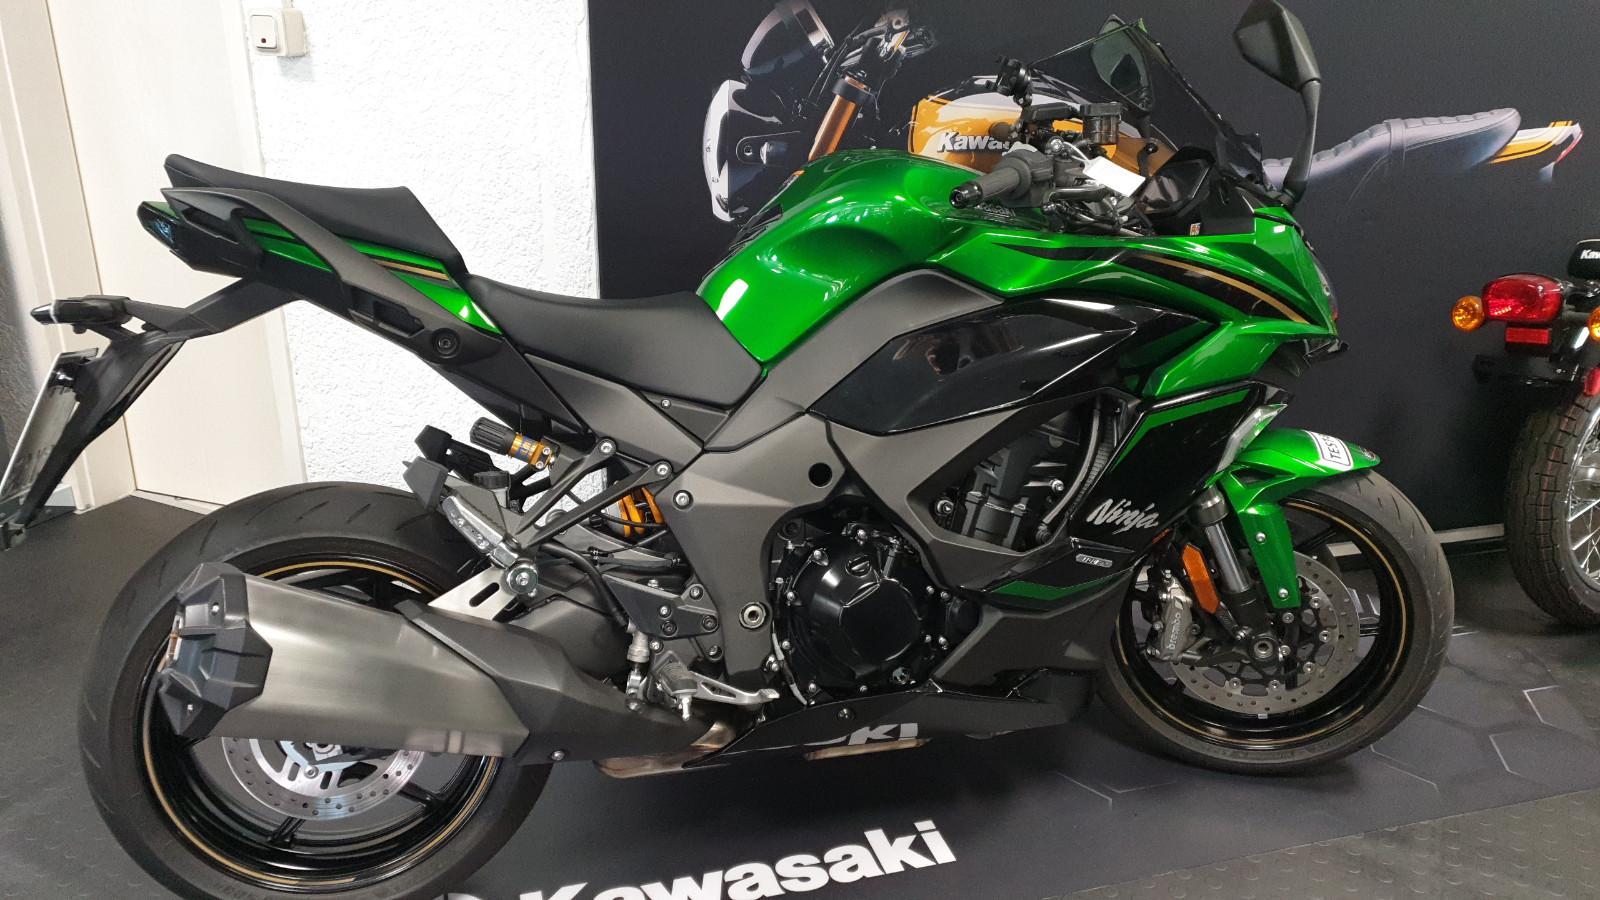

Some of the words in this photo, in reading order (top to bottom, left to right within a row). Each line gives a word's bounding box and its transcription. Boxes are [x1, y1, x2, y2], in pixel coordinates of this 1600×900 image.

[1086, 499, 1159, 535] Ninja
[1166, 612, 1181, 650] brembo
[520, 819, 957, 900] wasaki
